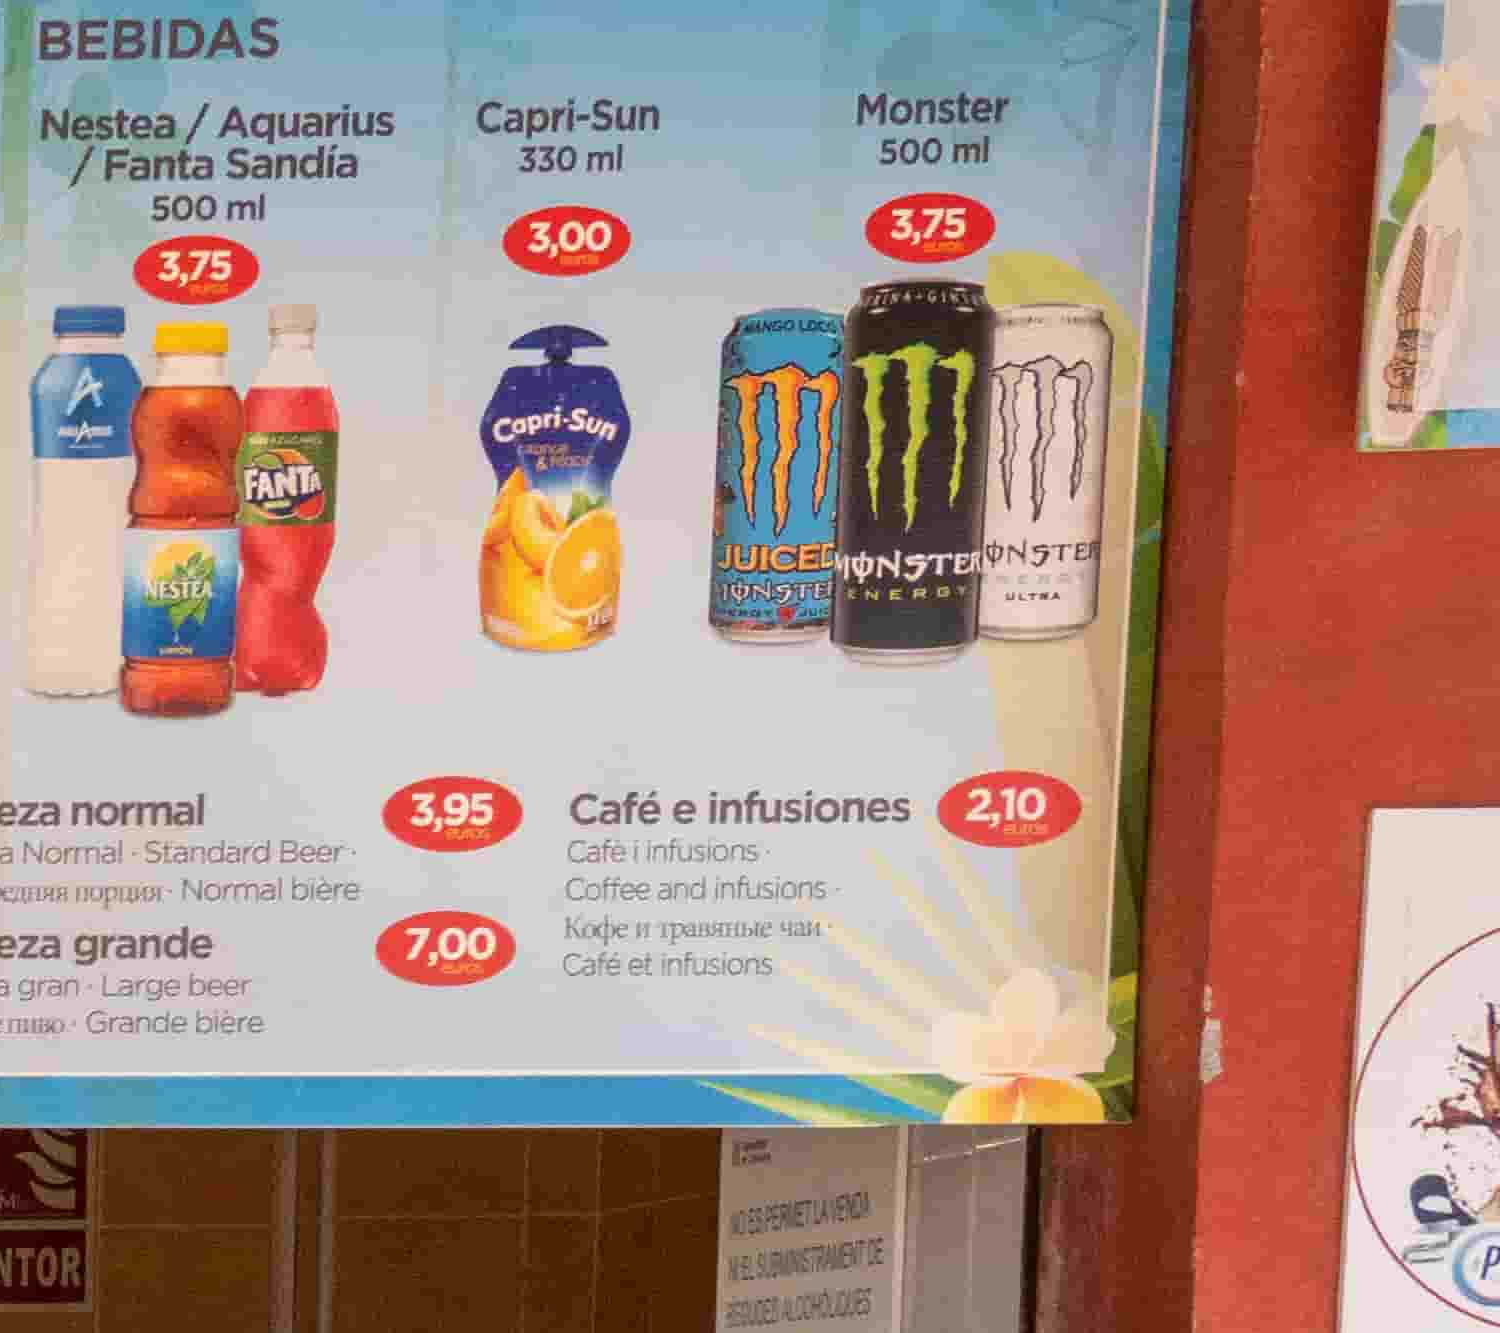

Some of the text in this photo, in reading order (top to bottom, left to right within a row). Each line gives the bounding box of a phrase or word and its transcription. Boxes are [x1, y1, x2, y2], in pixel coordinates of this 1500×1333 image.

[40, 18, 278, 60] BEBIDAS
[40, 108, 176, 141] Nestea
[218, 104, 395, 144] Aquarius
[476, 99, 659, 139] Capri-Sun
[857, 92, 1010, 125] Monster
[105, 148, 213, 181] Fanta
[226, 144, 358, 179] Sandía
[519, 144, 622, 172] 330 ml
[880, 136, 990, 165] 500 ml
[151, 193, 265, 221] 500 ml
[528, 221, 612, 258] 3,00
[891, 208, 966, 245] 3,75
[158, 250, 231, 286] 3,75
[492, 406, 618, 443] Capri-Sun
[244, 464, 323, 501] FANTA
[72, 794, 204, 826] normal
[411, 792, 493, 831] 3,95
[570, 790, 910, 825] Café e infusiones
[965, 787, 1046, 827] 2,10
[23, 840, 122, 864] Normal
[145, 840, 271, 864] Standard
[280, 840, 344, 863] Beer
[74, 926, 212, 965] grande
[406, 927, 496, 966] 7,00
